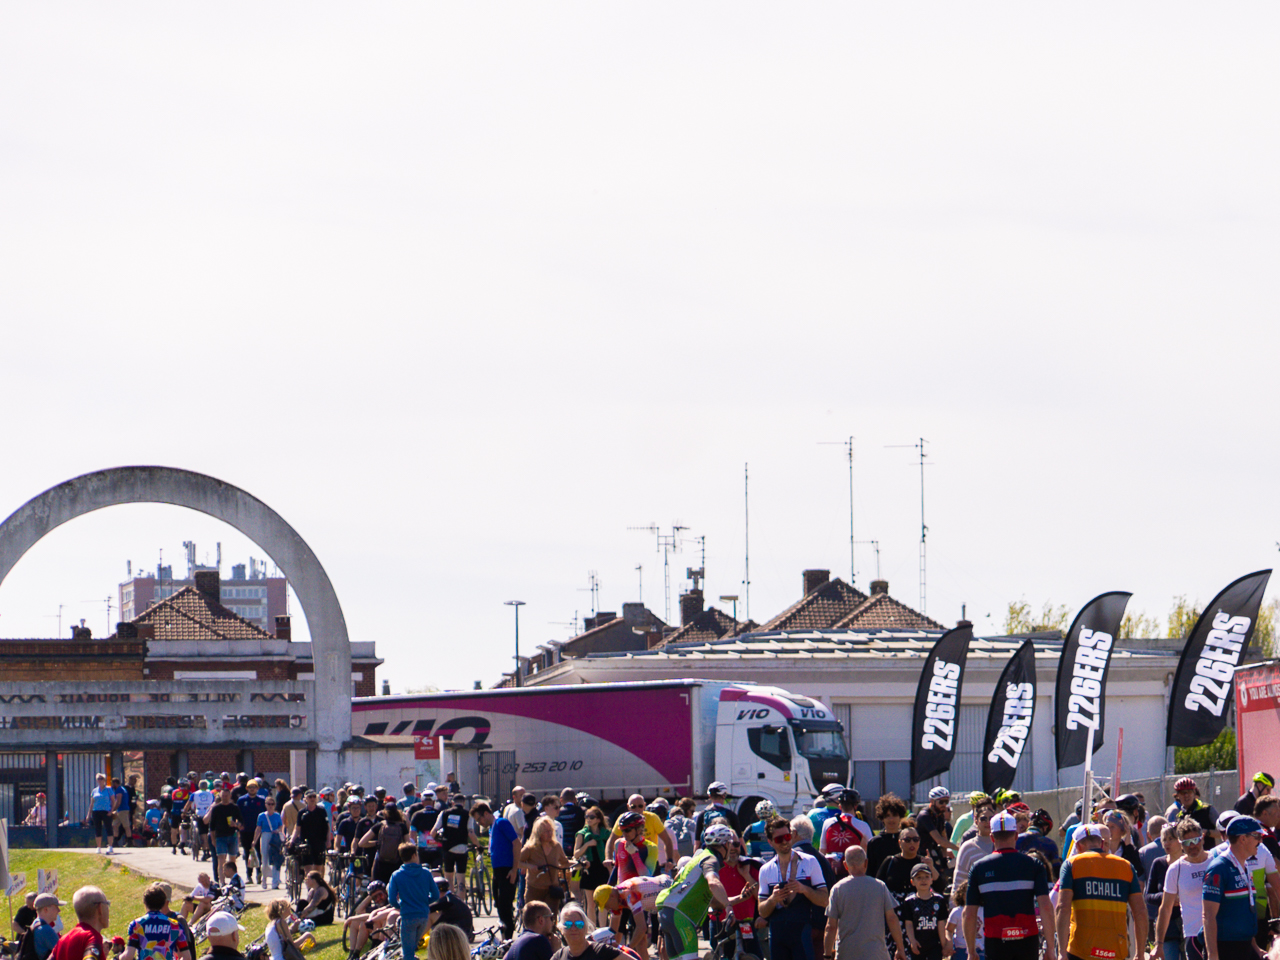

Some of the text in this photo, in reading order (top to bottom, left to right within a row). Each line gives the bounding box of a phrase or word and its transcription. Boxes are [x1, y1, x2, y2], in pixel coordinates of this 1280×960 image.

[1185, 612, 1252, 717] 226ERS
[1066, 628, 1114, 730] 226ERS
[1249, 687, 1259, 700] YOU
[1259, 686, 1268, 699] ARE
[921, 660, 961, 751] 226ERS
[736, 708, 770, 721] VIO
[800, 708, 826, 719] VIO
[988, 682, 1034, 768] 226ERS
[522, 762, 547, 773] 253
[549, 761, 567, 772] 20
[570, 760, 584, 771] 10
[1085, 881, 1122, 898] BCHALL
[144, 924, 170, 934] MAPEI
